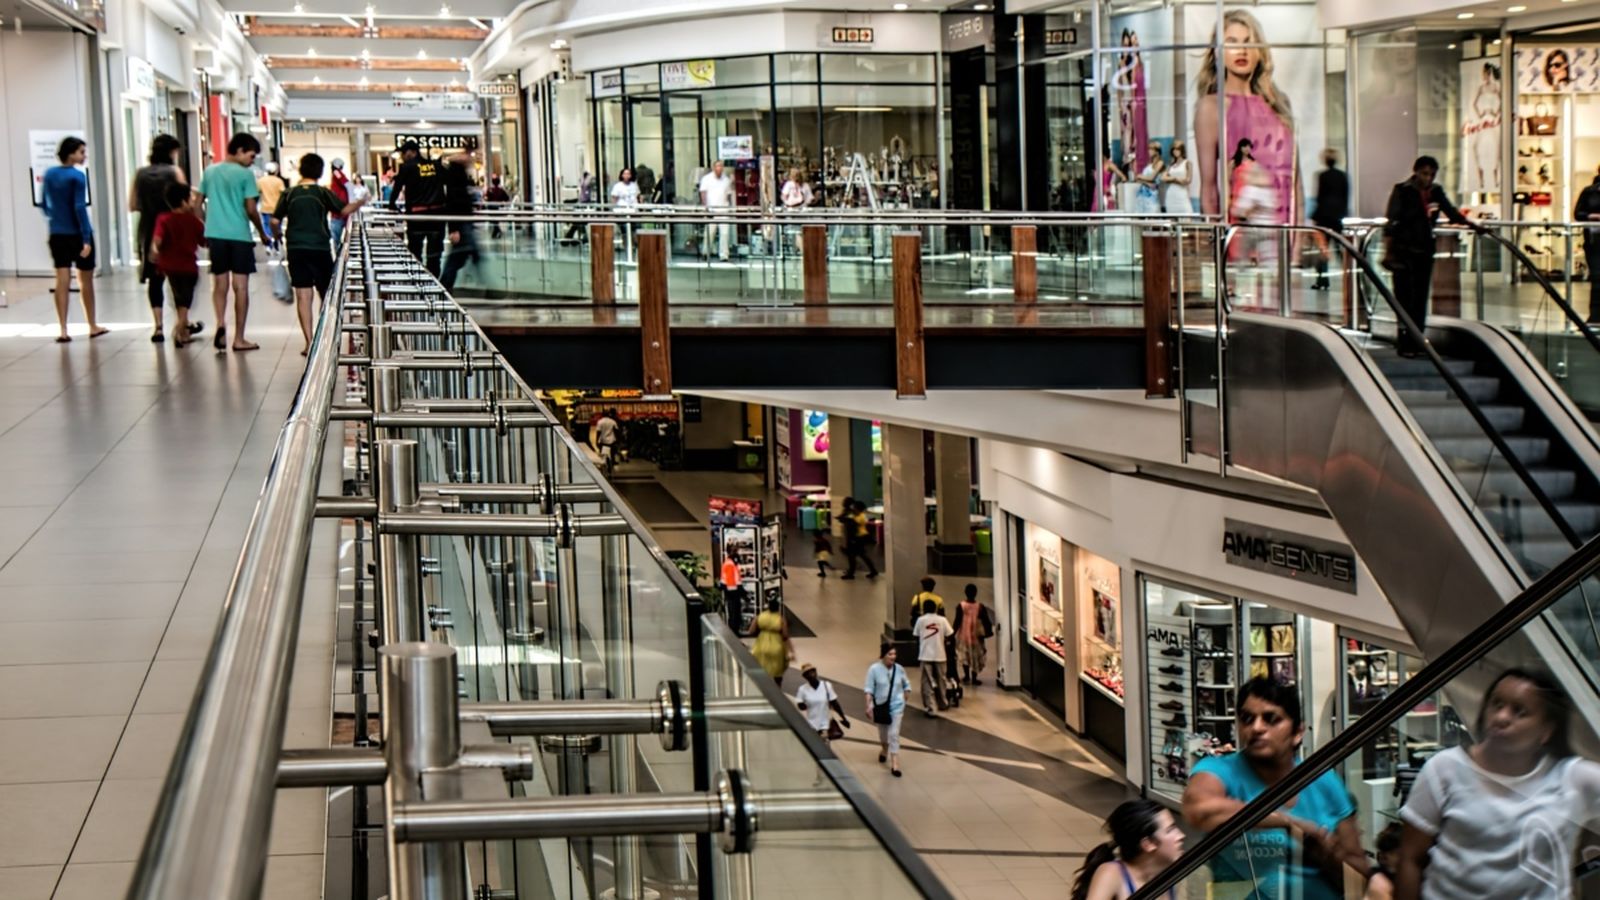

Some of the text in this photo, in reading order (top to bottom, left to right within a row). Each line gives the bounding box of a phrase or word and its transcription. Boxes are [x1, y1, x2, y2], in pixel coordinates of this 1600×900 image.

[1222, 530, 1350, 582] AMA GENTS
[1147, 627, 1180, 649] AMA
